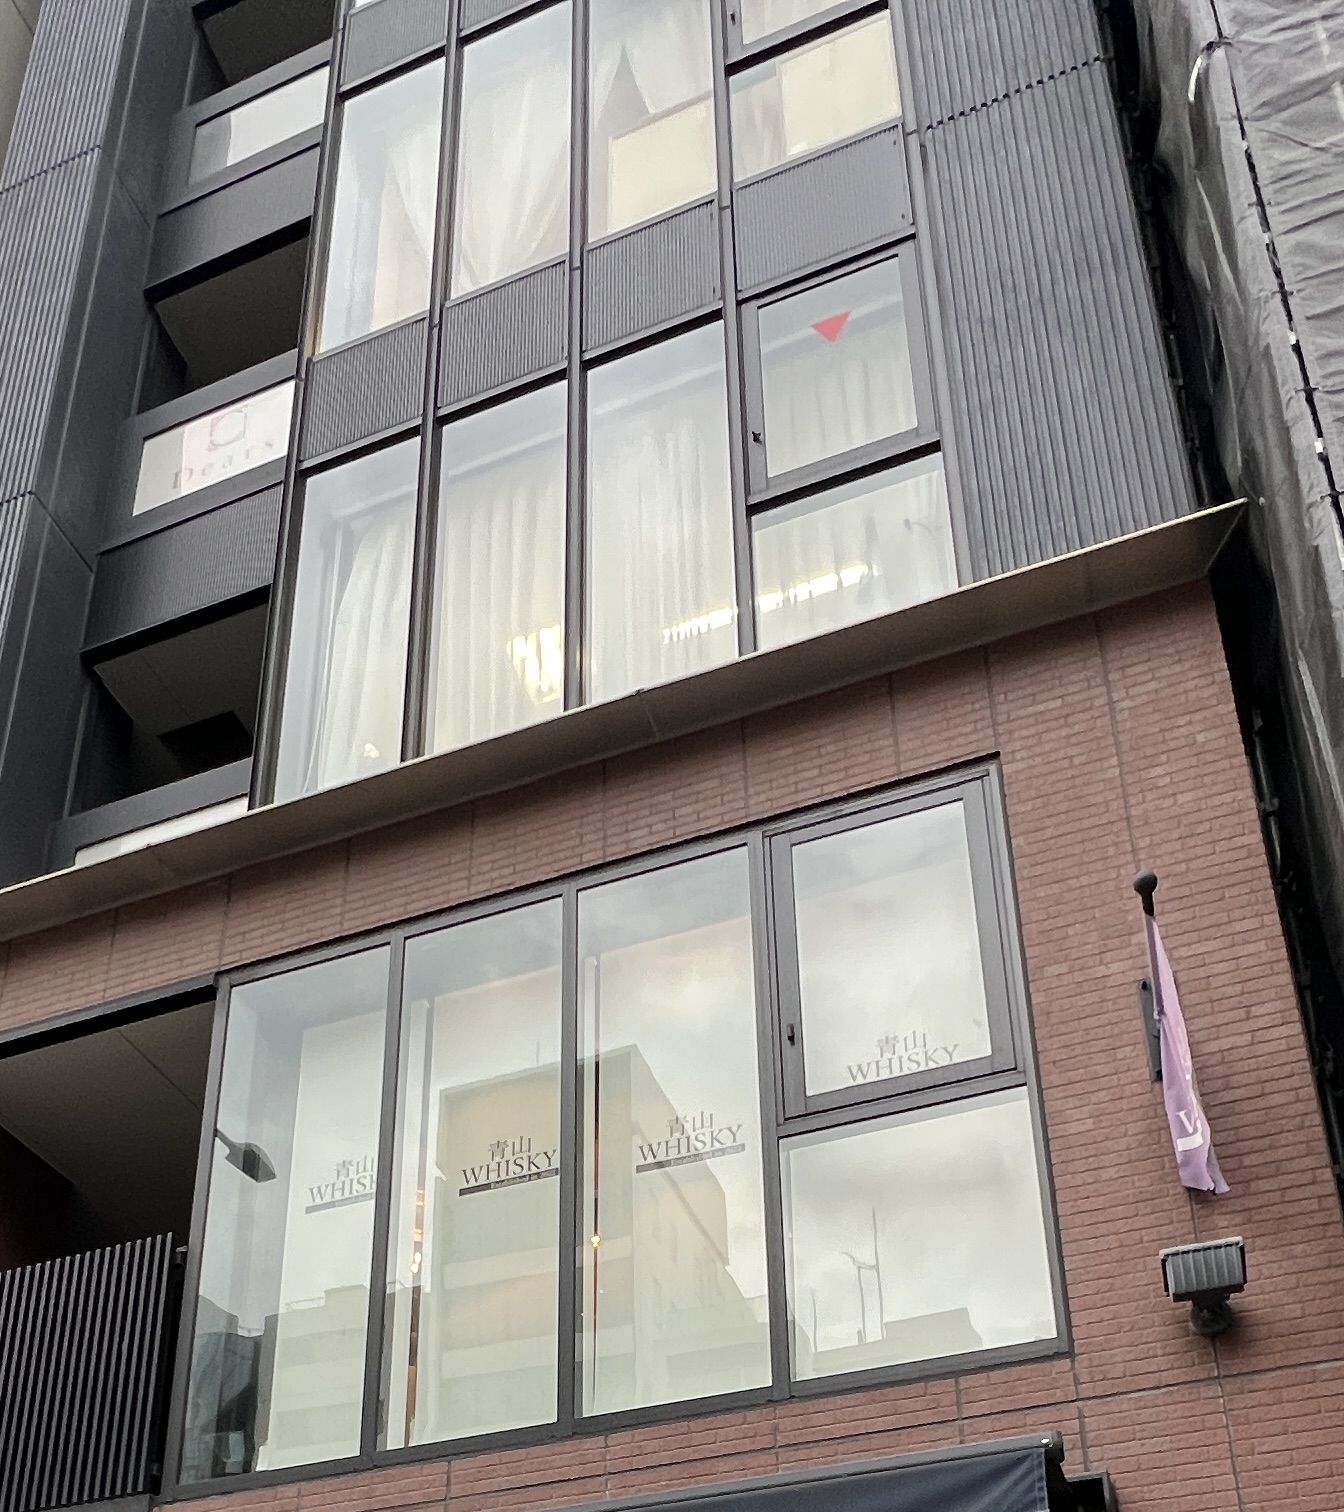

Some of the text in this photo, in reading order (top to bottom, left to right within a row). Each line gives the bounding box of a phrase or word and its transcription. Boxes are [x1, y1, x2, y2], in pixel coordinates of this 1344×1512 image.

[846, 1044, 959, 1083] WHISKY
[639, 1124, 742, 1163] WHISKY
[462, 1149, 557, 1185] WHISKY
